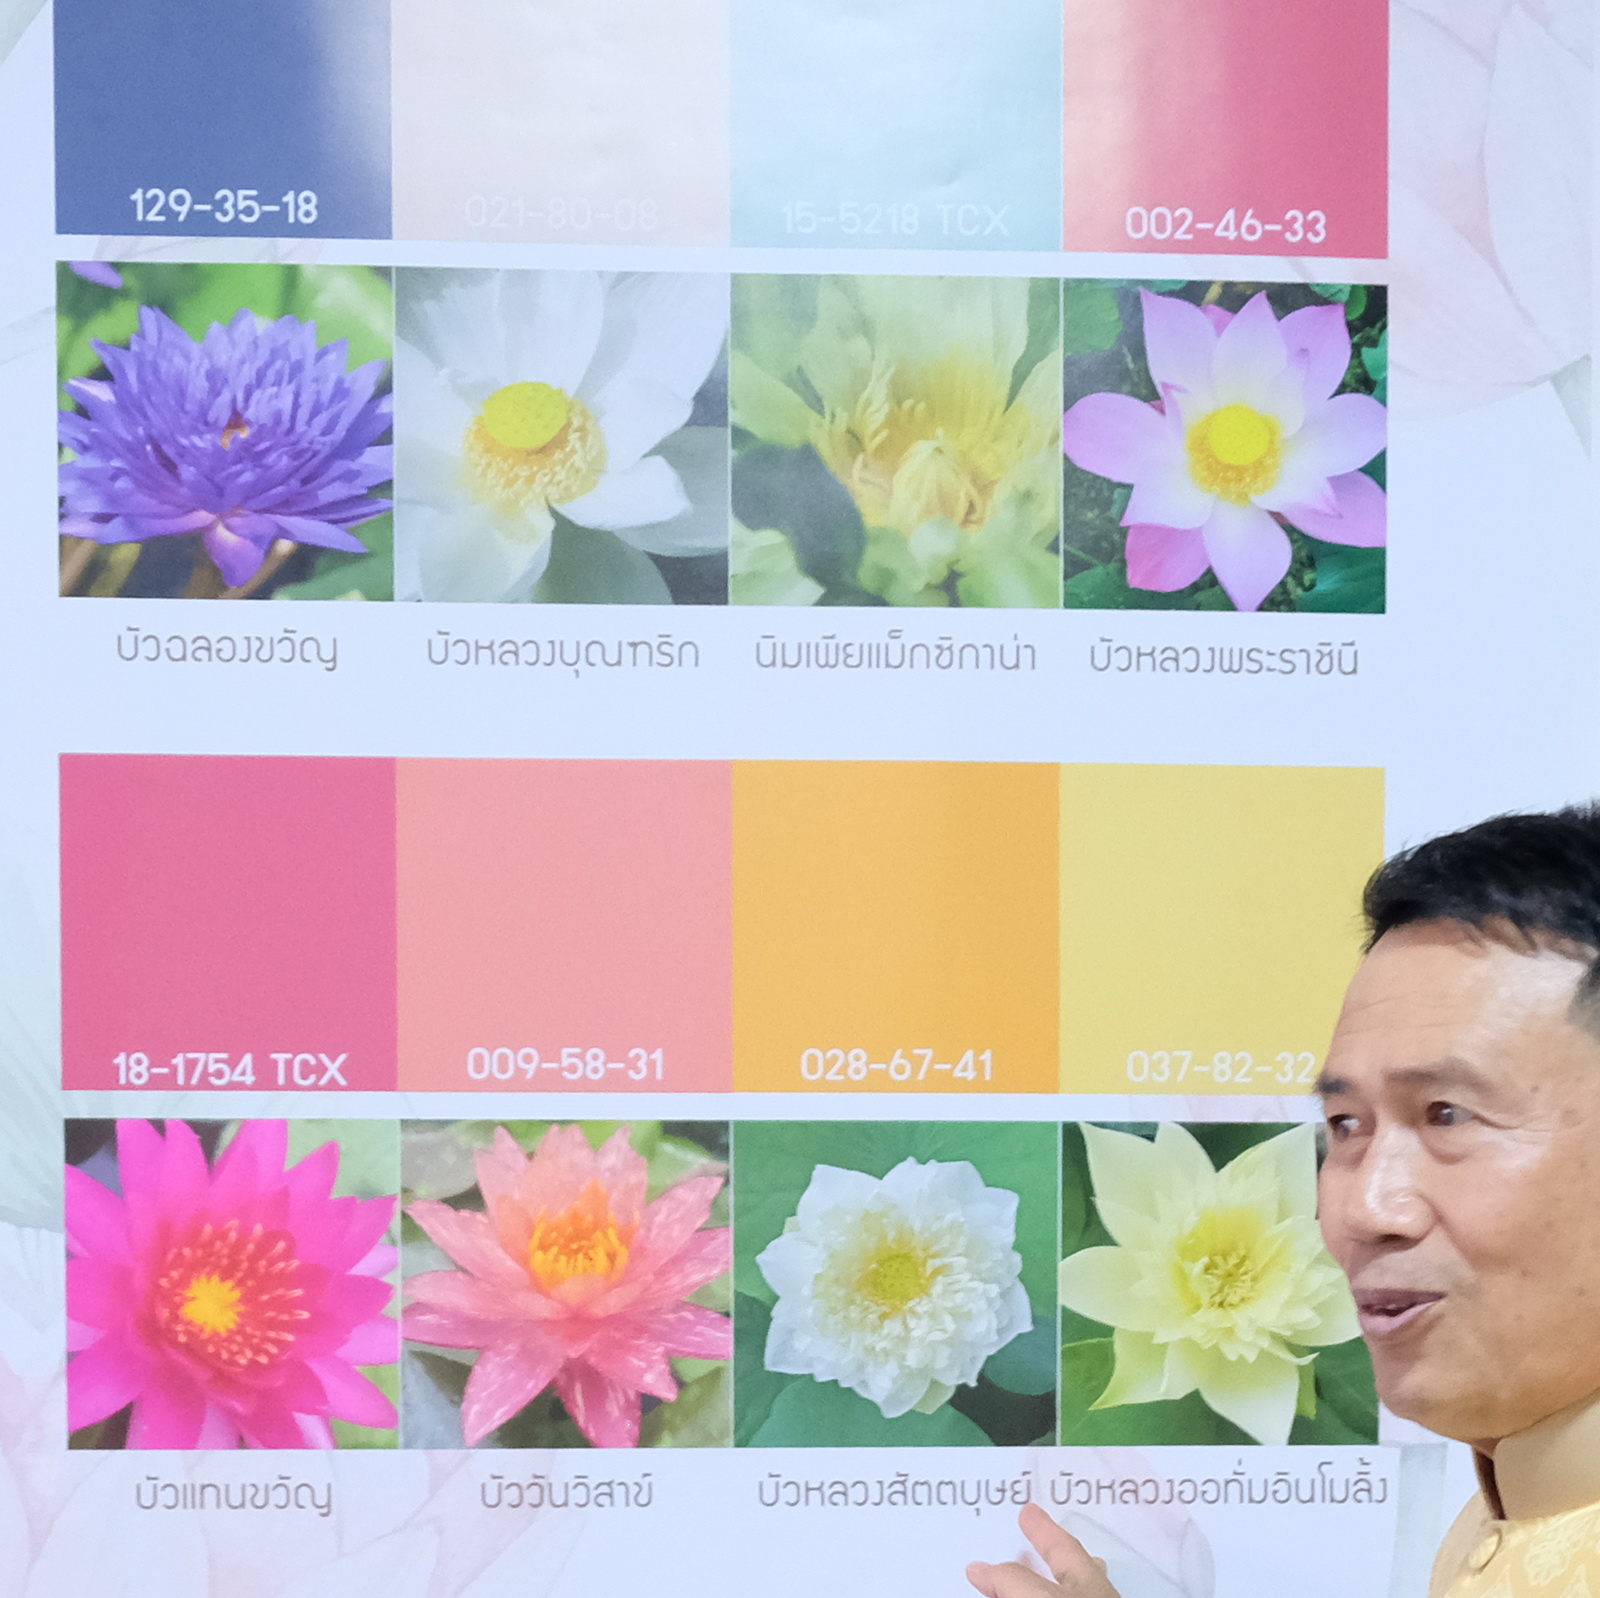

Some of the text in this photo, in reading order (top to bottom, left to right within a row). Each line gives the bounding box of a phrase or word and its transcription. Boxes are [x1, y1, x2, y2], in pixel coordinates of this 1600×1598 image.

[129, 187, 319, 224] 129-35-18
[780, 201, 1012, 237] 15-5218 TCX
[1126, 206, 1328, 244] 002-46-33
[116, 625, 338, 673] บัวฉลองขวัญ
[1089, 636, 1360, 677] บัวหลวงพระราชินี
[112, 1051, 349, 1086] 18-1754 TCX
[466, 1046, 665, 1081] 009-58-31
[800, 1047, 994, 1081] 028-67-41
[1126, 1049, 1316, 1084] 037-82-32
[135, 1474, 333, 1519] บัวแทนขวัญ
[480, 1472, 654, 1510] บัววันวิสาข์
[758, 1470, 1033, 1517] บัวหลวงสัตตบุษย์
